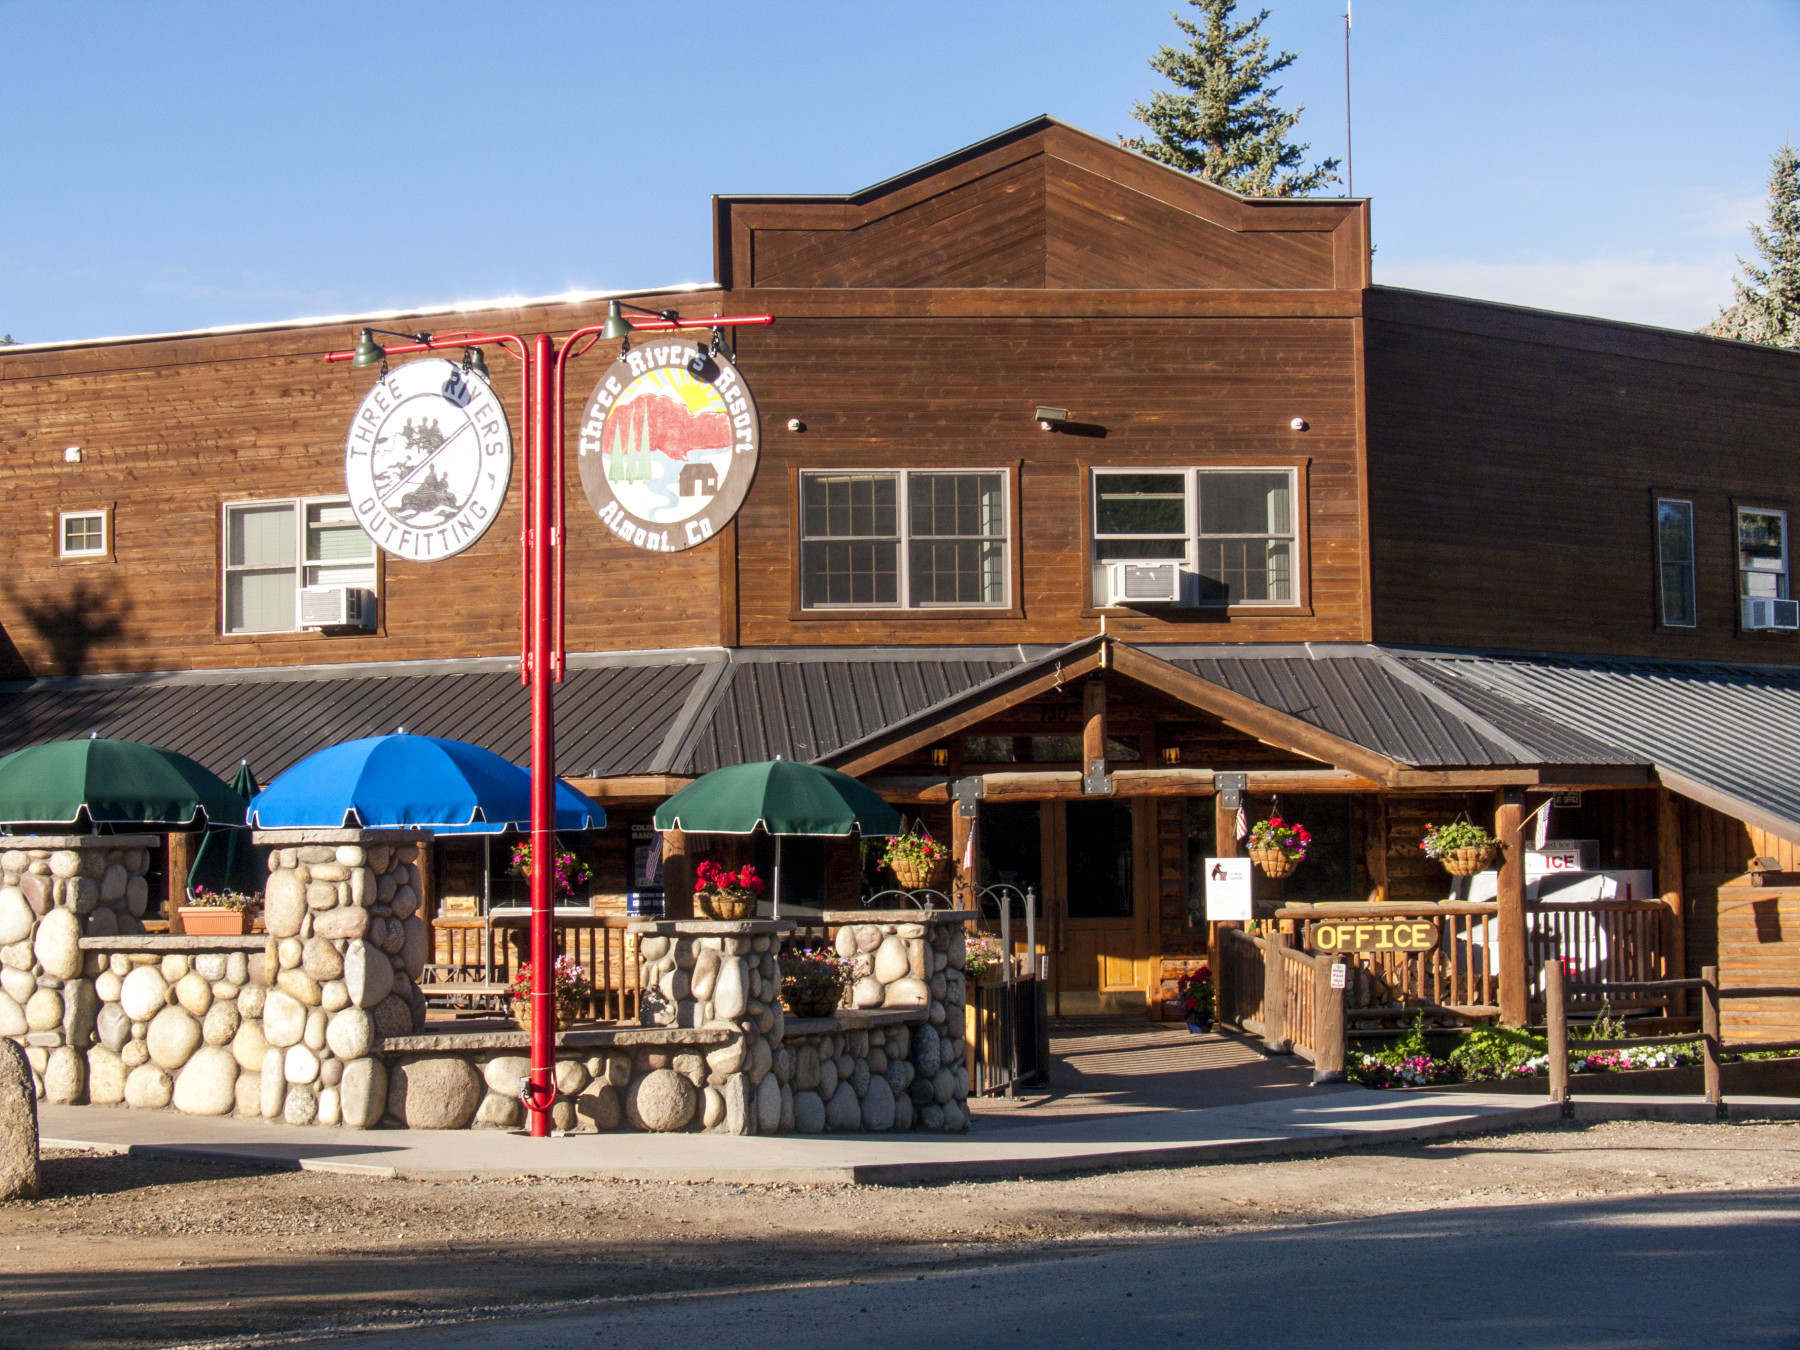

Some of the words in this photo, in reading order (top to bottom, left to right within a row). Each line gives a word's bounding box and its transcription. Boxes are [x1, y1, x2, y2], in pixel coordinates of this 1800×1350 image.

[350, 378, 402, 459] THREE
[445, 370, 504, 457] RIVERS
[580, 376, 622, 456] Three
[626, 345, 707, 376] Rivers
[714, 366, 754, 454] Resort
[358, 497, 488, 556] OUTFITTING
[684, 517, 713, 546] Co
[1545, 855, 1575, 869] ICE
[1317, 924, 1430, 949] OFFICE
